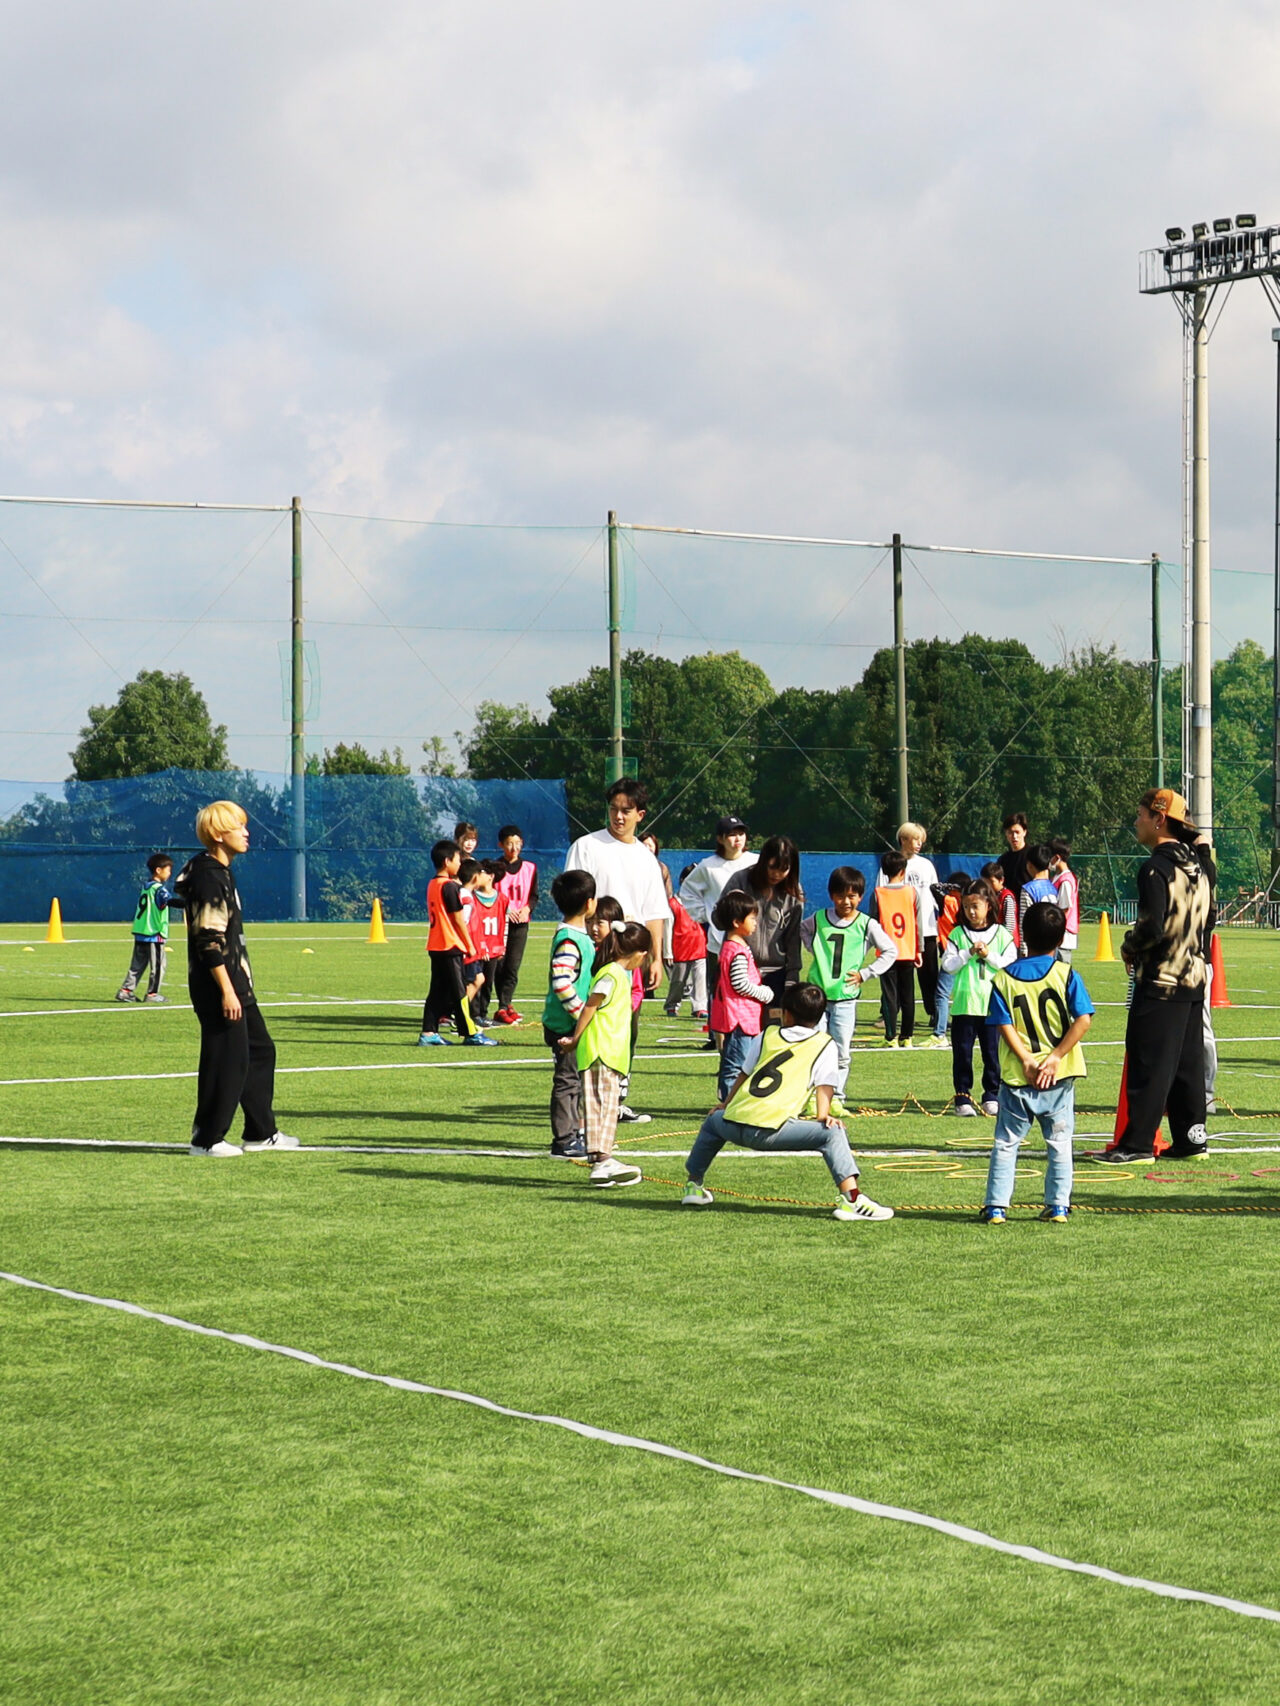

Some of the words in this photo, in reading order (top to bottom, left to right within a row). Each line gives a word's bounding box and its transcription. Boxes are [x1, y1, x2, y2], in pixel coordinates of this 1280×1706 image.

[137, 893, 149, 920] 9
[507, 885, 521, 902] 11
[482, 916, 498, 936] 11
[891, 911, 906, 939] 9
[826, 932, 845, 979] 1
[1012, 988, 1071, 1053] 10
[748, 1048, 795, 1098] 6
